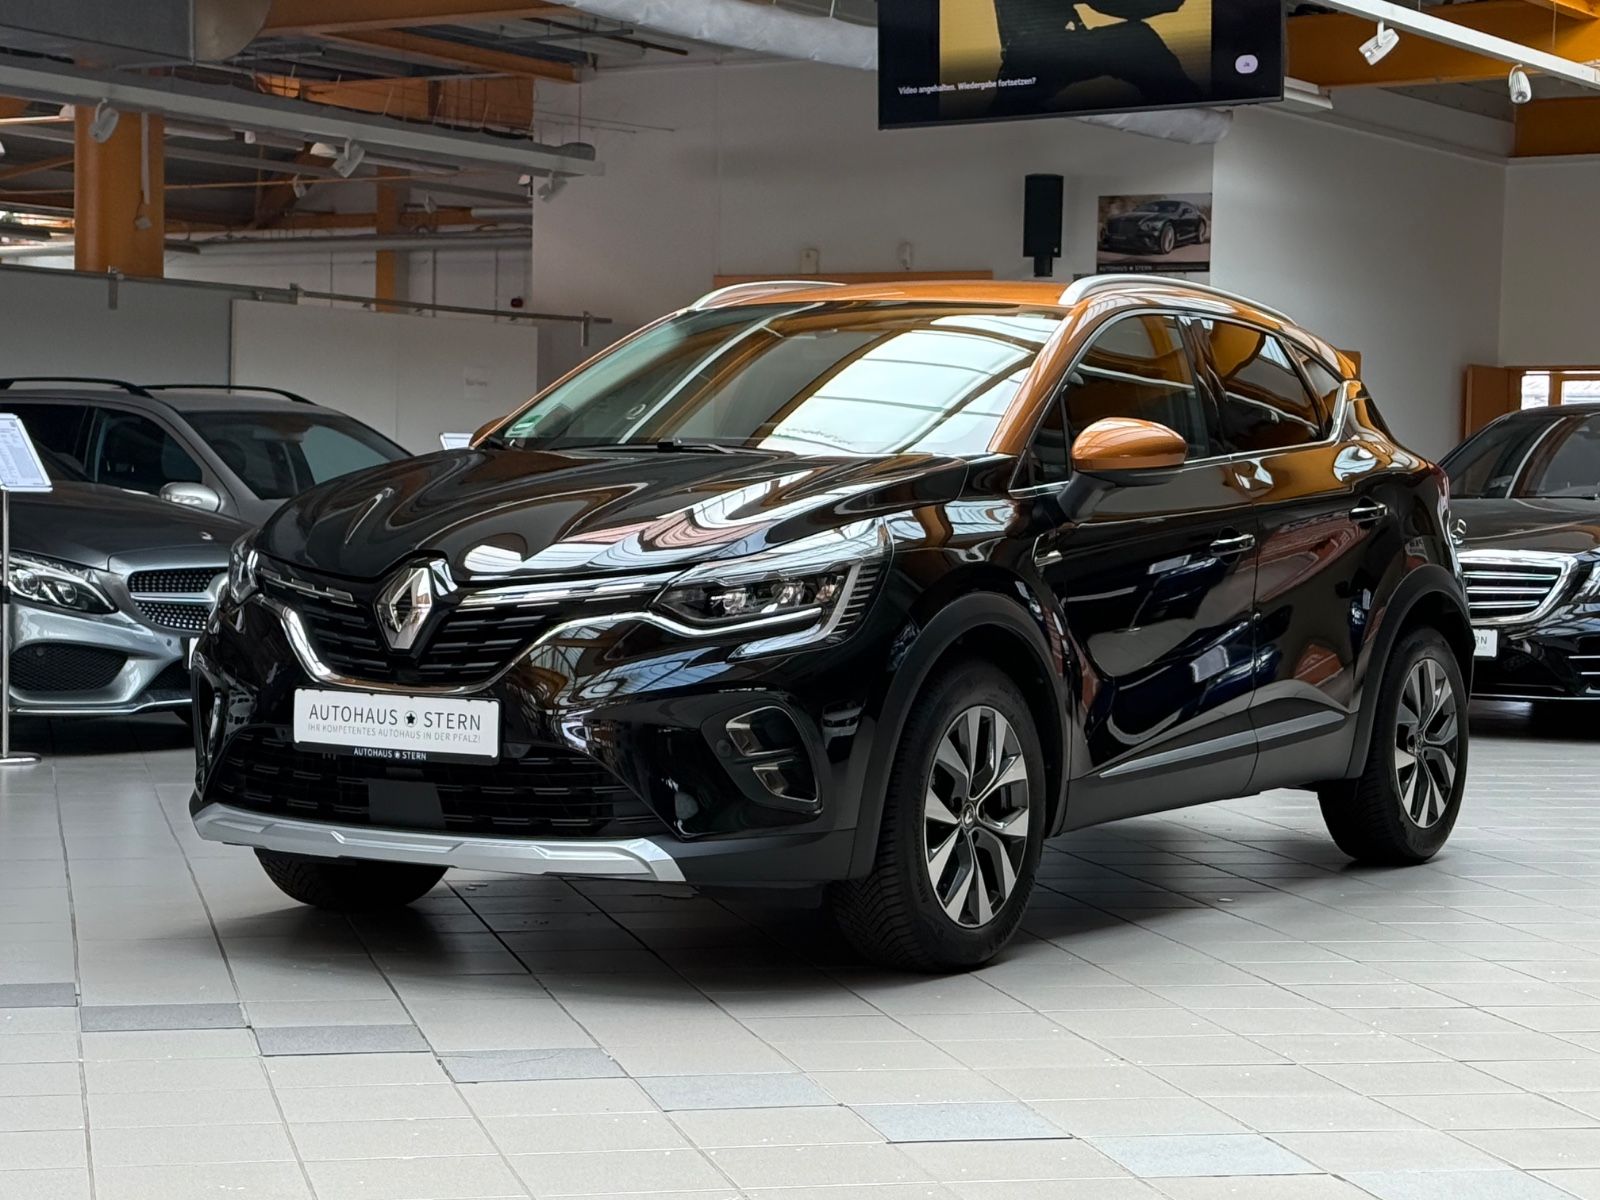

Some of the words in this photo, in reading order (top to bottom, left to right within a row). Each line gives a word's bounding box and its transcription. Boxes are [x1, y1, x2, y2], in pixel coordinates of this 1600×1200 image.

[898, 86, 918, 95] Video
[919, 84, 956, 95] angehalten.
[957, 81, 997, 91] Wiedergabe
[998, 76, 1037, 87] fortsetzen?
[309, 704, 398, 725] AUTOHAUS
[423, 711, 480, 731] STERN
[307, 723, 320, 732] IHR
[322, 725, 376, 737] KOMPETENTES
[378, 728, 421, 740] AUTOHAUS
[423, 732, 432, 740] IN
[434, 732, 451, 741] DER
[353, 747, 393, 759] AUTOHAUS
[402, 751, 427, 760] STERN
